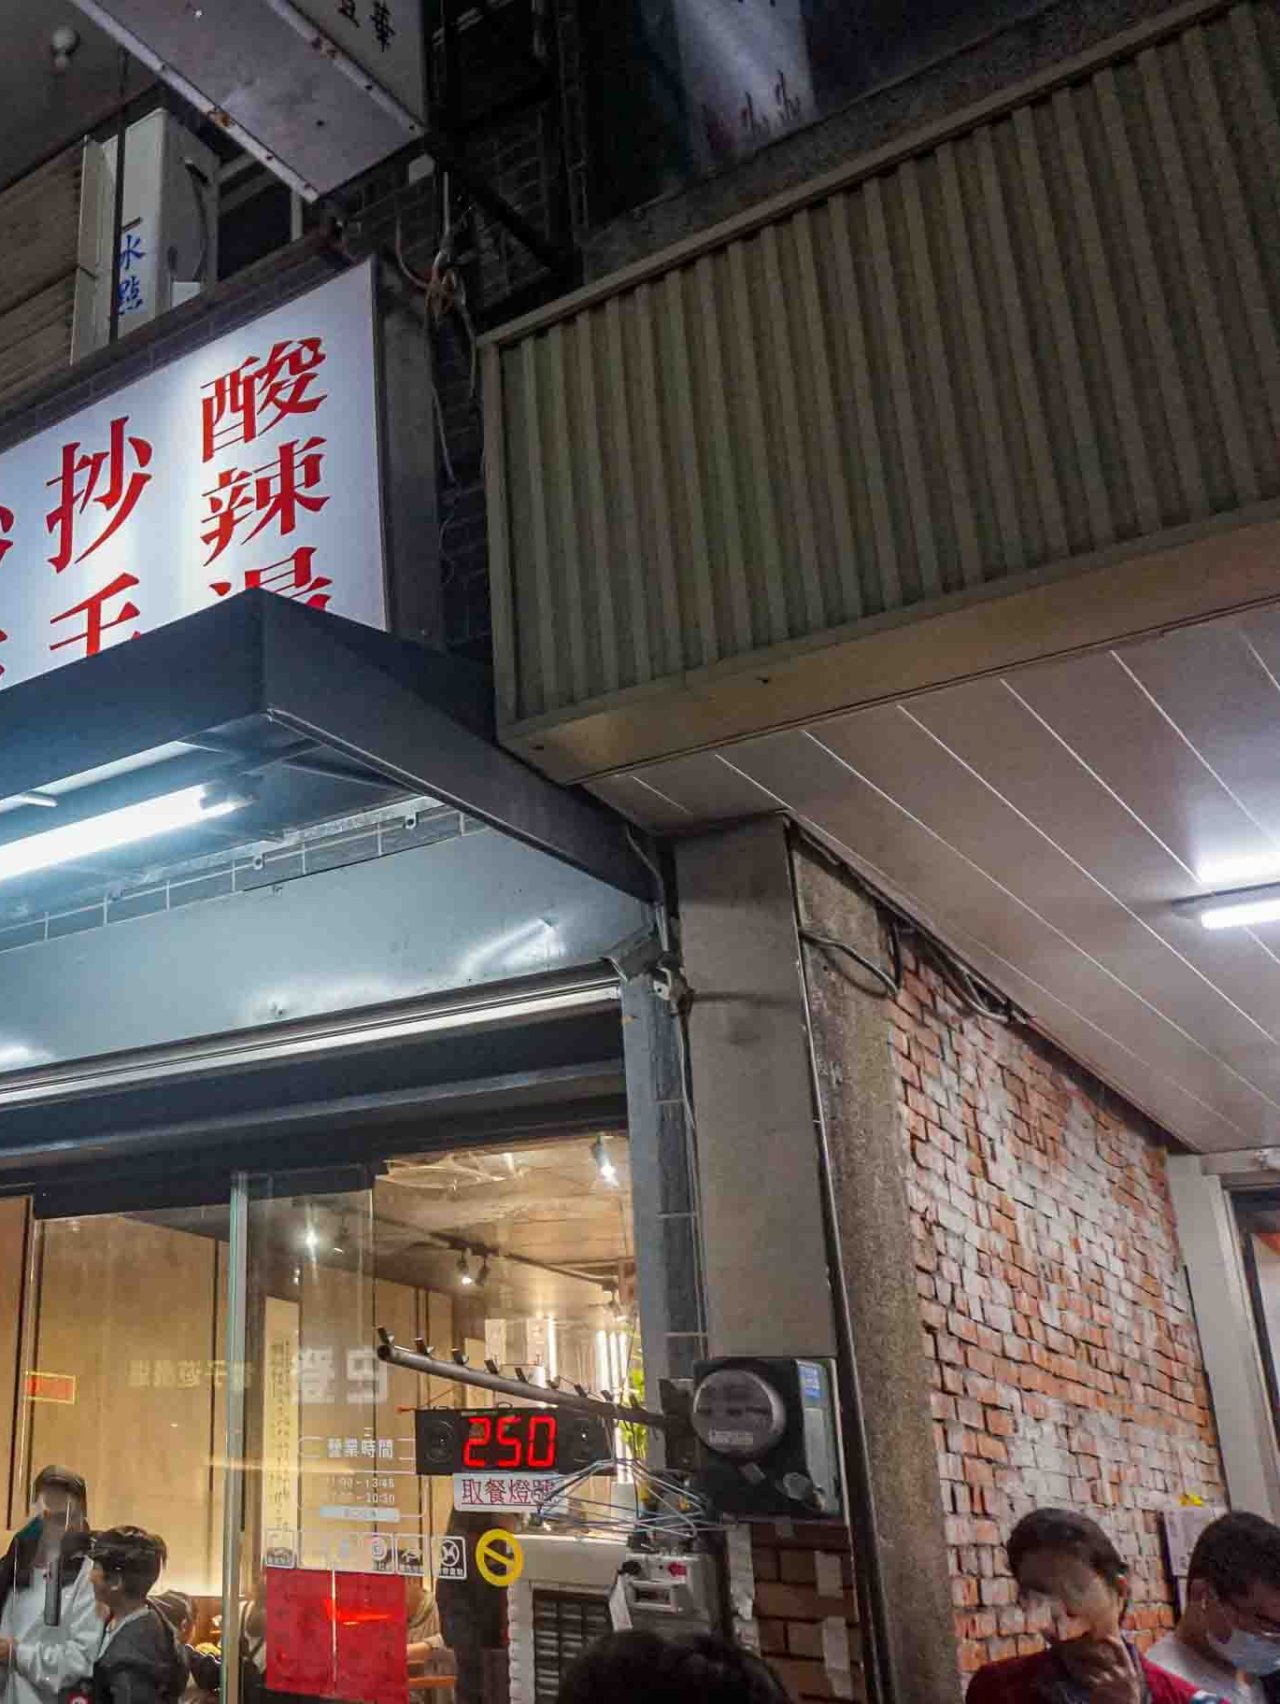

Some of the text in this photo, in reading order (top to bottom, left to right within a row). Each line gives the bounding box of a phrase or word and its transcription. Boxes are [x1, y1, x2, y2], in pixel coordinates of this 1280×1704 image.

[463, 1415, 557, 1468] 250
[461, 1478, 556, 1504] 取餐燈號
